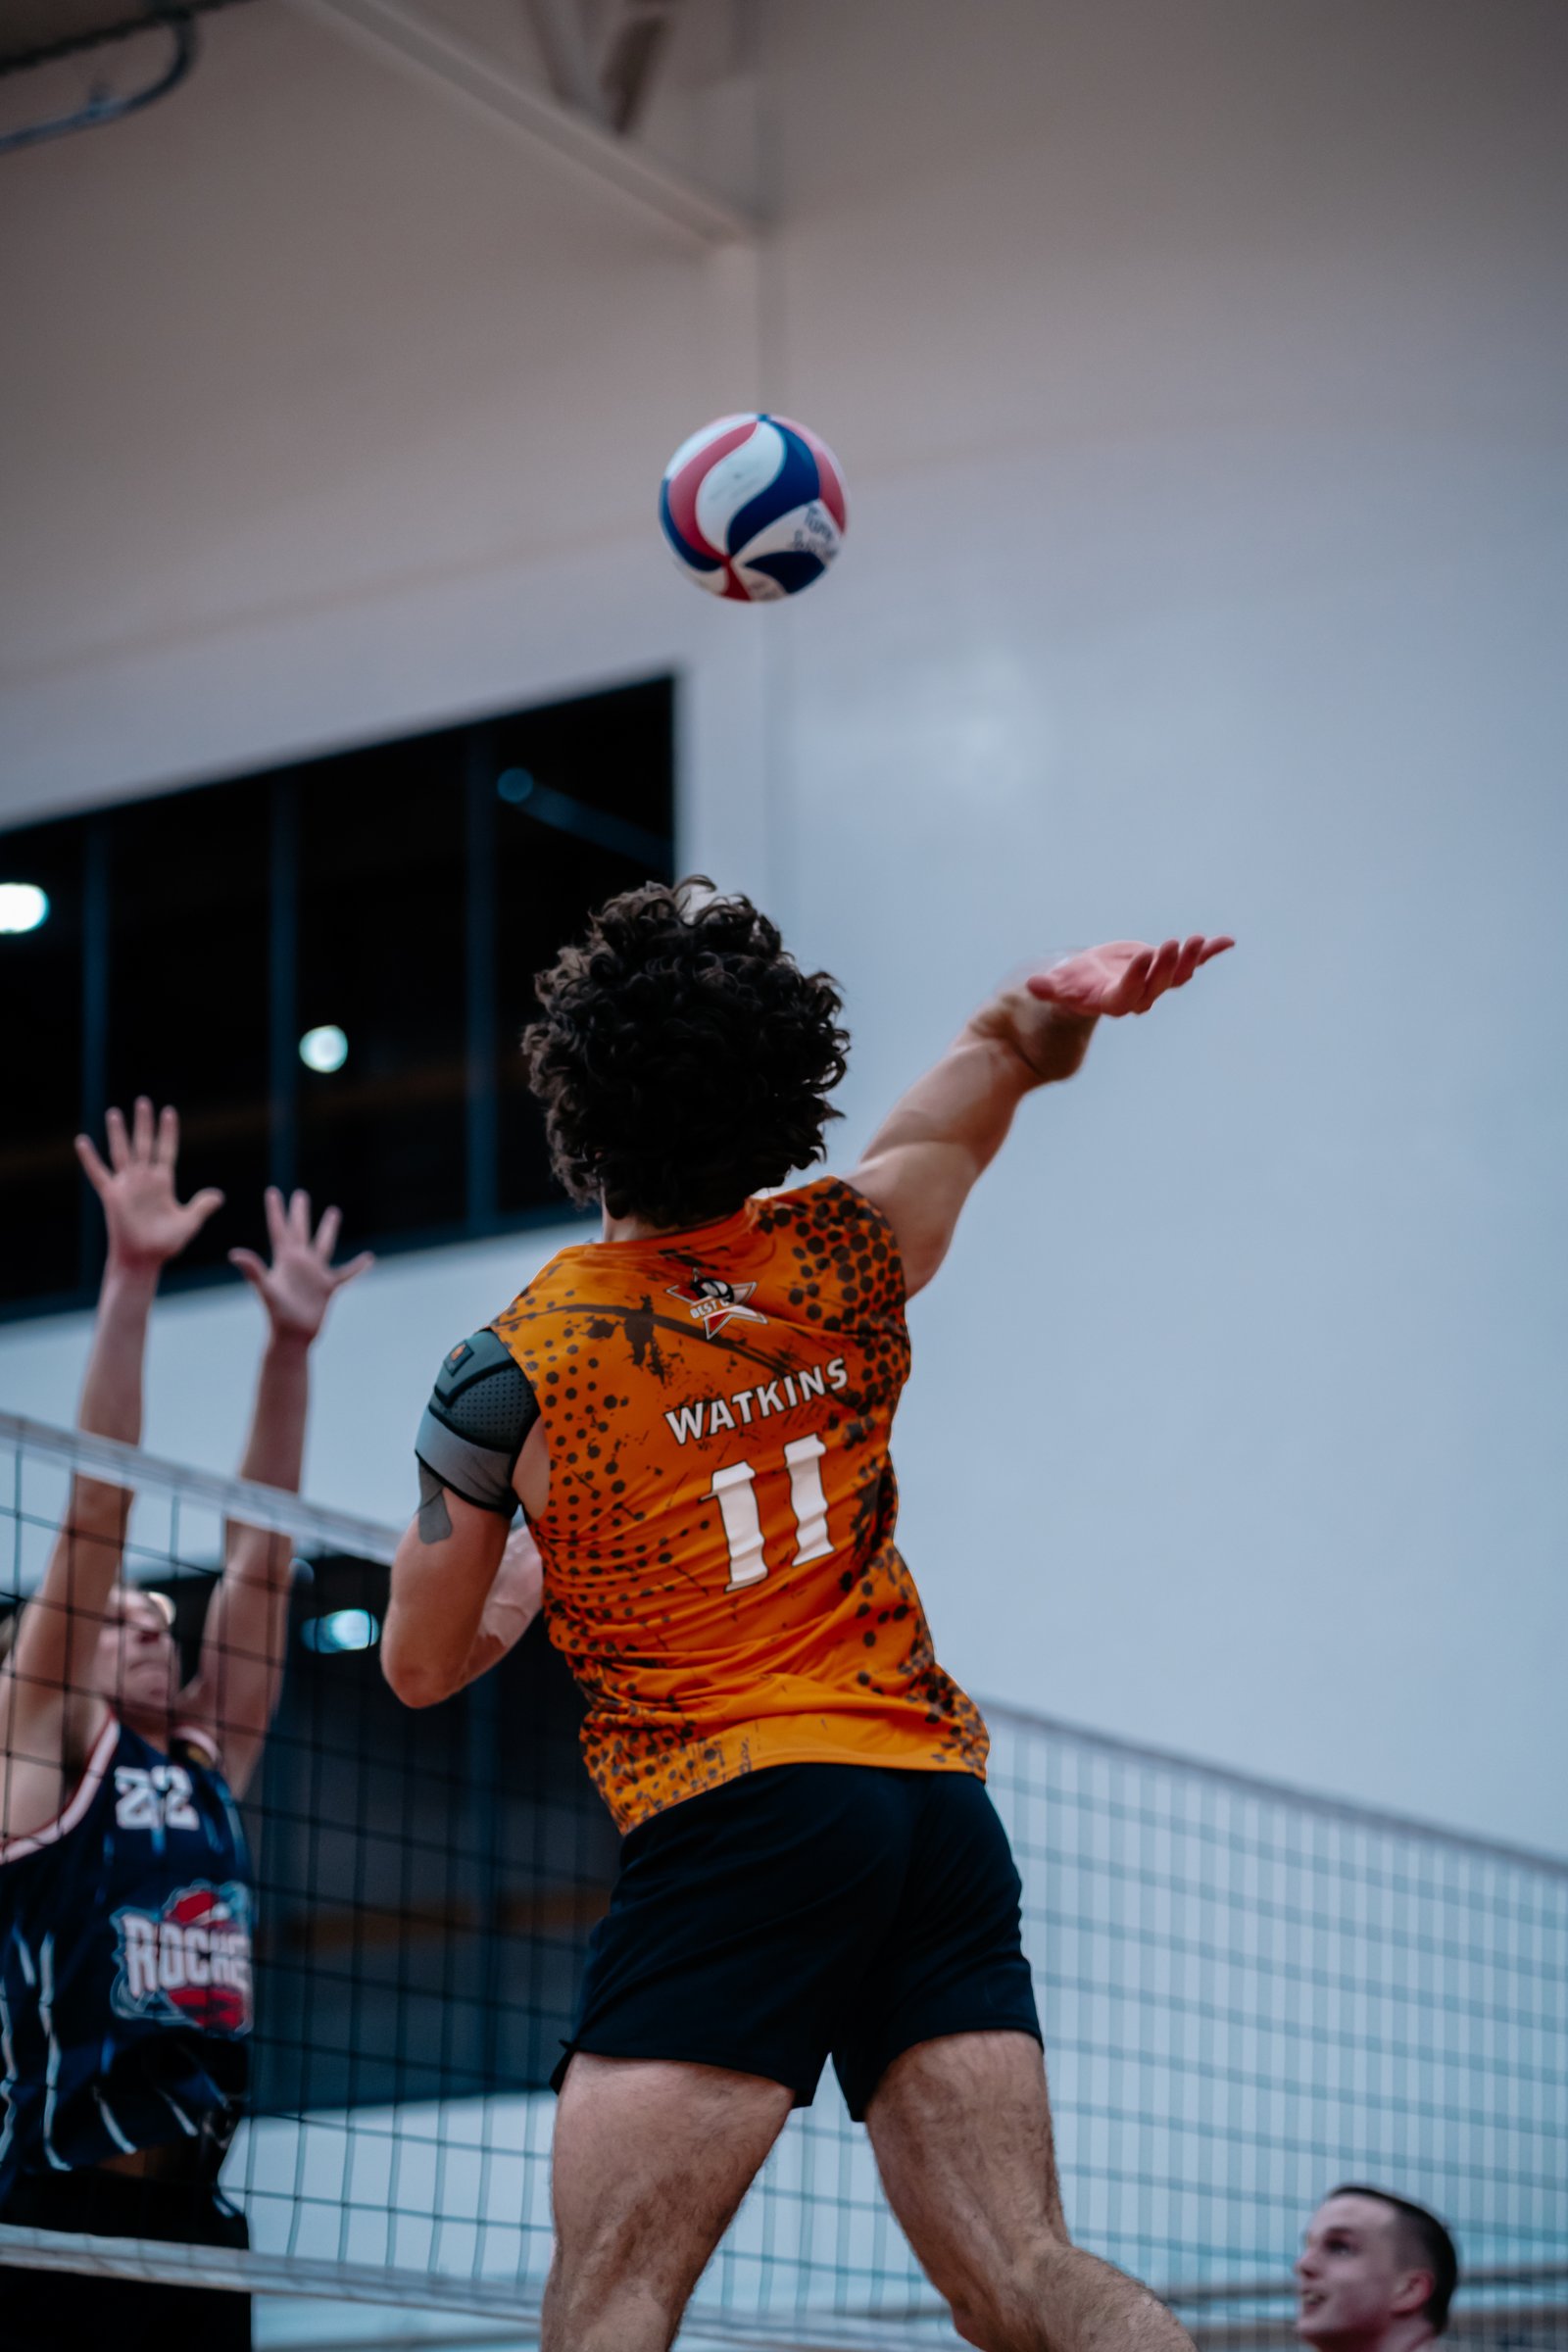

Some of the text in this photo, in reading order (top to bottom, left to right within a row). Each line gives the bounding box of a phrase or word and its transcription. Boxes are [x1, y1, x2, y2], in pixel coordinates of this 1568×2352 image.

[691, 1300, 717, 1318] BEST
[664, 1357, 849, 1446] WATKINS
[700, 1434, 835, 1592] 11
[115, 1765, 200, 1830] 22
